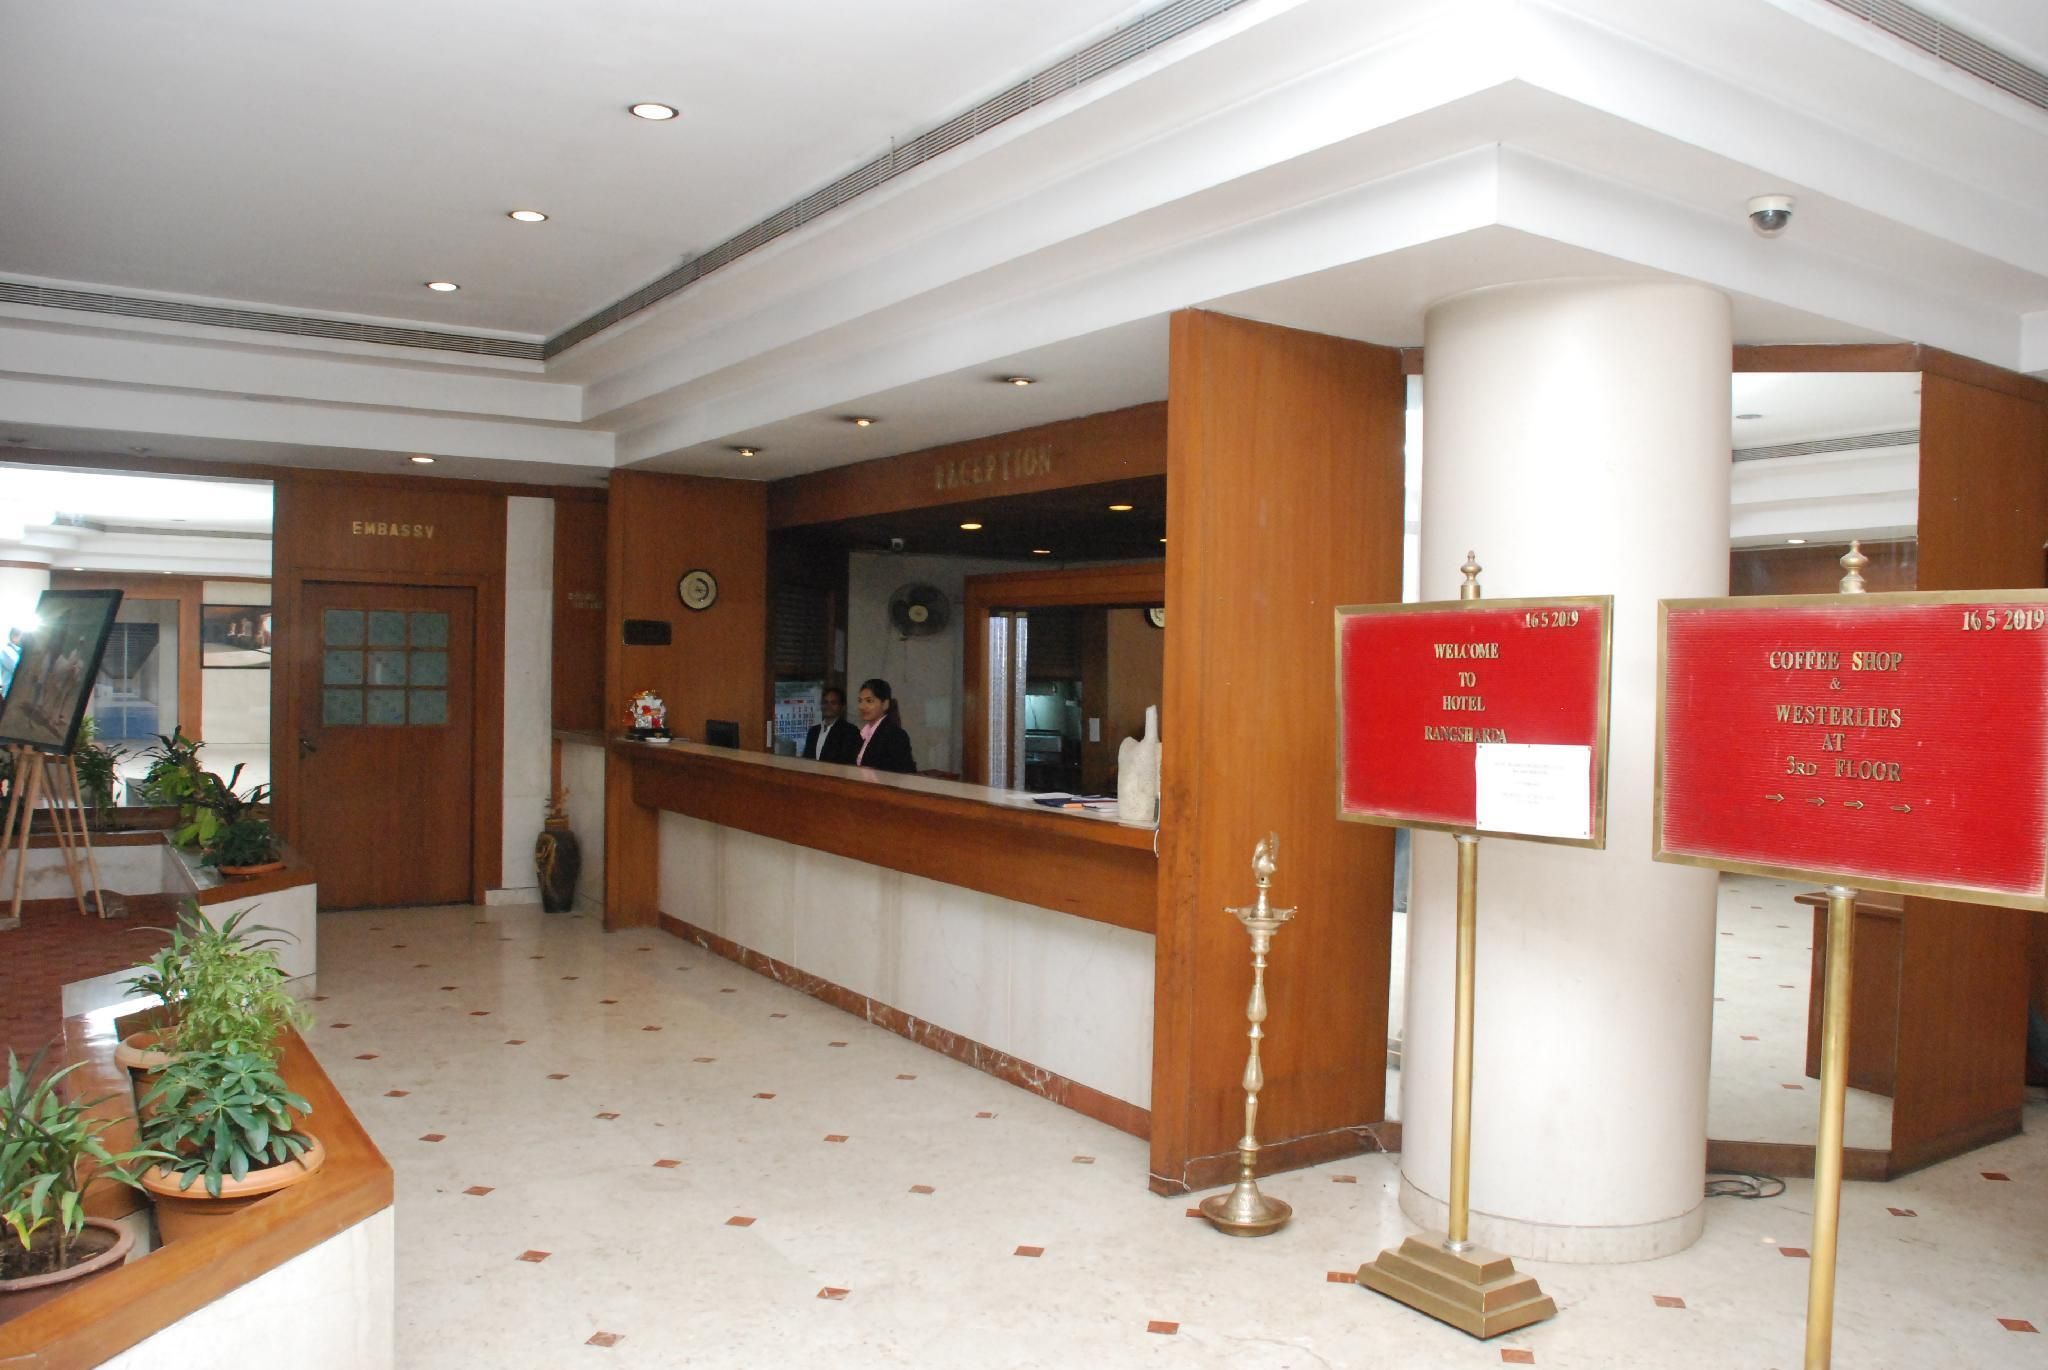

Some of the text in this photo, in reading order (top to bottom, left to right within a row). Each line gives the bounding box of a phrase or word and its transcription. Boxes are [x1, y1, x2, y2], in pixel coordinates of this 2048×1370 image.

[352, 520, 435, 539] EMBASSY
[1525, 610, 1579, 628] 16 5 2019
[1962, 608, 2045, 631] 16 5 2019
[1433, 642, 1499, 659] WELCOME
[1768, 650, 1903, 672] COFFEE SHOP
[1458, 671, 1477, 688] TO
[1829, 677, 1842, 691] &
[1442, 695, 1486, 712] HOTEL
[1775, 704, 1903, 729] WESTERLIES
[1424, 725, 1508, 744] RANGSHARDA
[1821, 733, 1845, 752] AT
[1784, 755, 1902, 783] 3RD FLOOR
